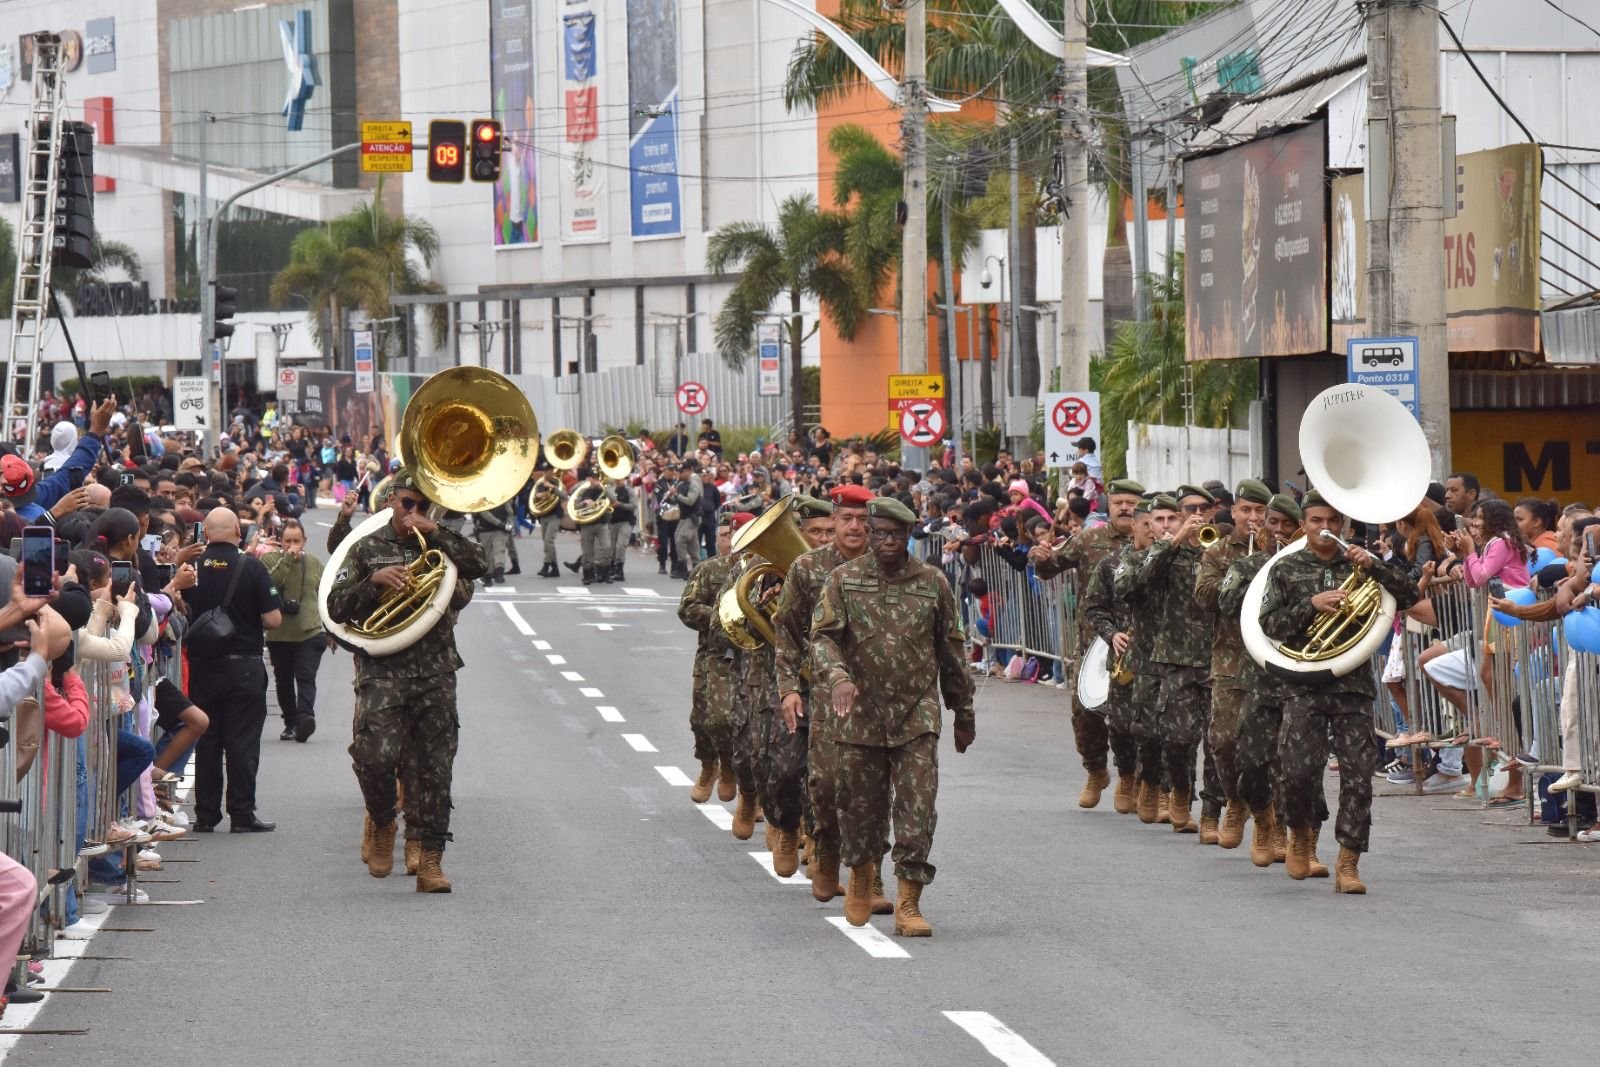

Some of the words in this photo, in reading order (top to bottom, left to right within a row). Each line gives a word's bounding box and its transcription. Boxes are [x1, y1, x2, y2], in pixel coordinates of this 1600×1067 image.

[369, 143, 405, 153] ATENÇÃO
[436, 146, 457, 165] 09
[894, 379, 923, 387] DIREITA
[1357, 374, 1384, 383] Ponto
[1385, 373, 1410, 382] 0318
[898, 388, 919, 396] LIVRE
[1323, 389, 1365, 410] JUPITER
